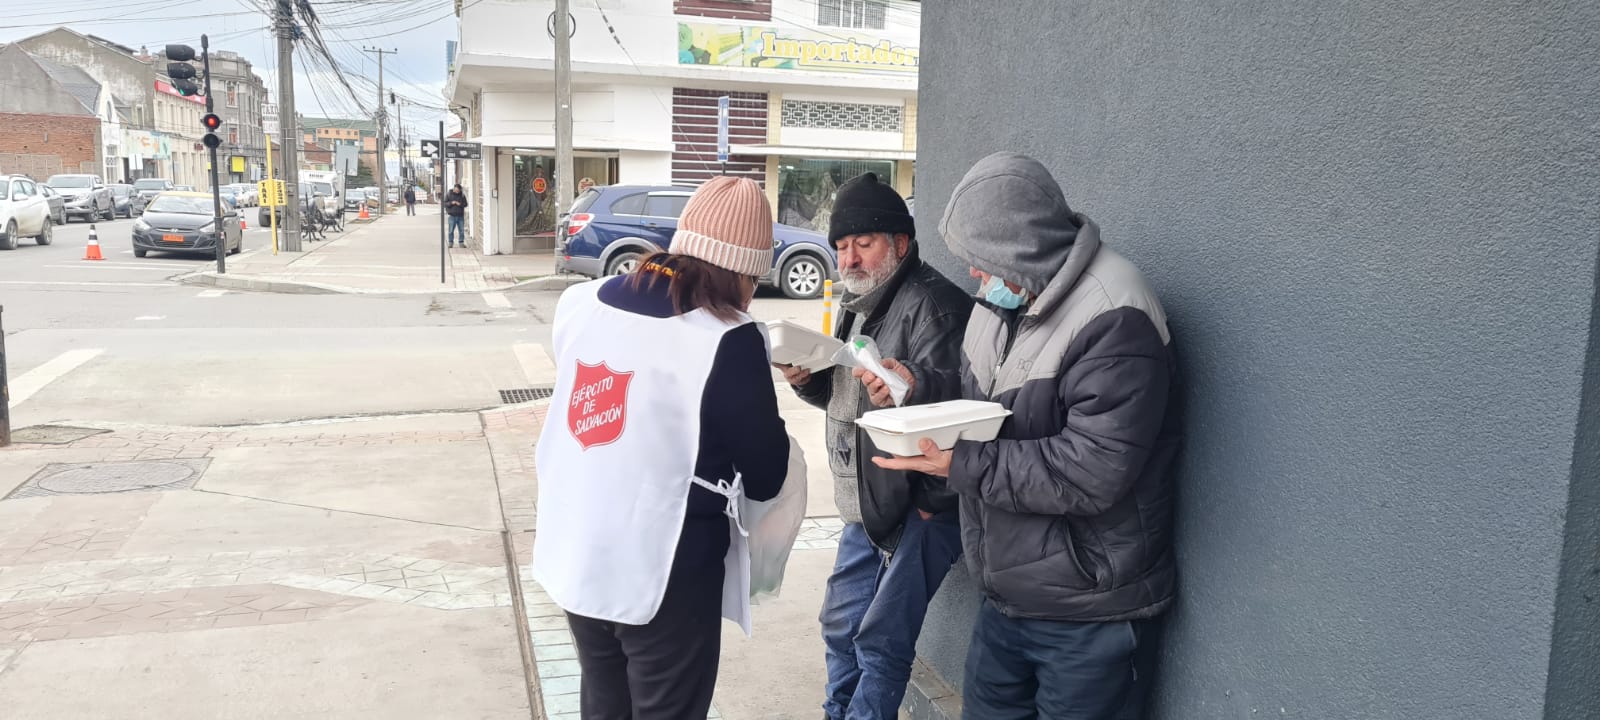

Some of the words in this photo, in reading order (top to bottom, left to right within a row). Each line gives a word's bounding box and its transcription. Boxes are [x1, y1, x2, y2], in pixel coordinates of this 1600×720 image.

[571, 375, 614, 408] EJÉRCITO
[582, 399, 597, 415] DE
[574, 403, 623, 436] SALVACIÓN
